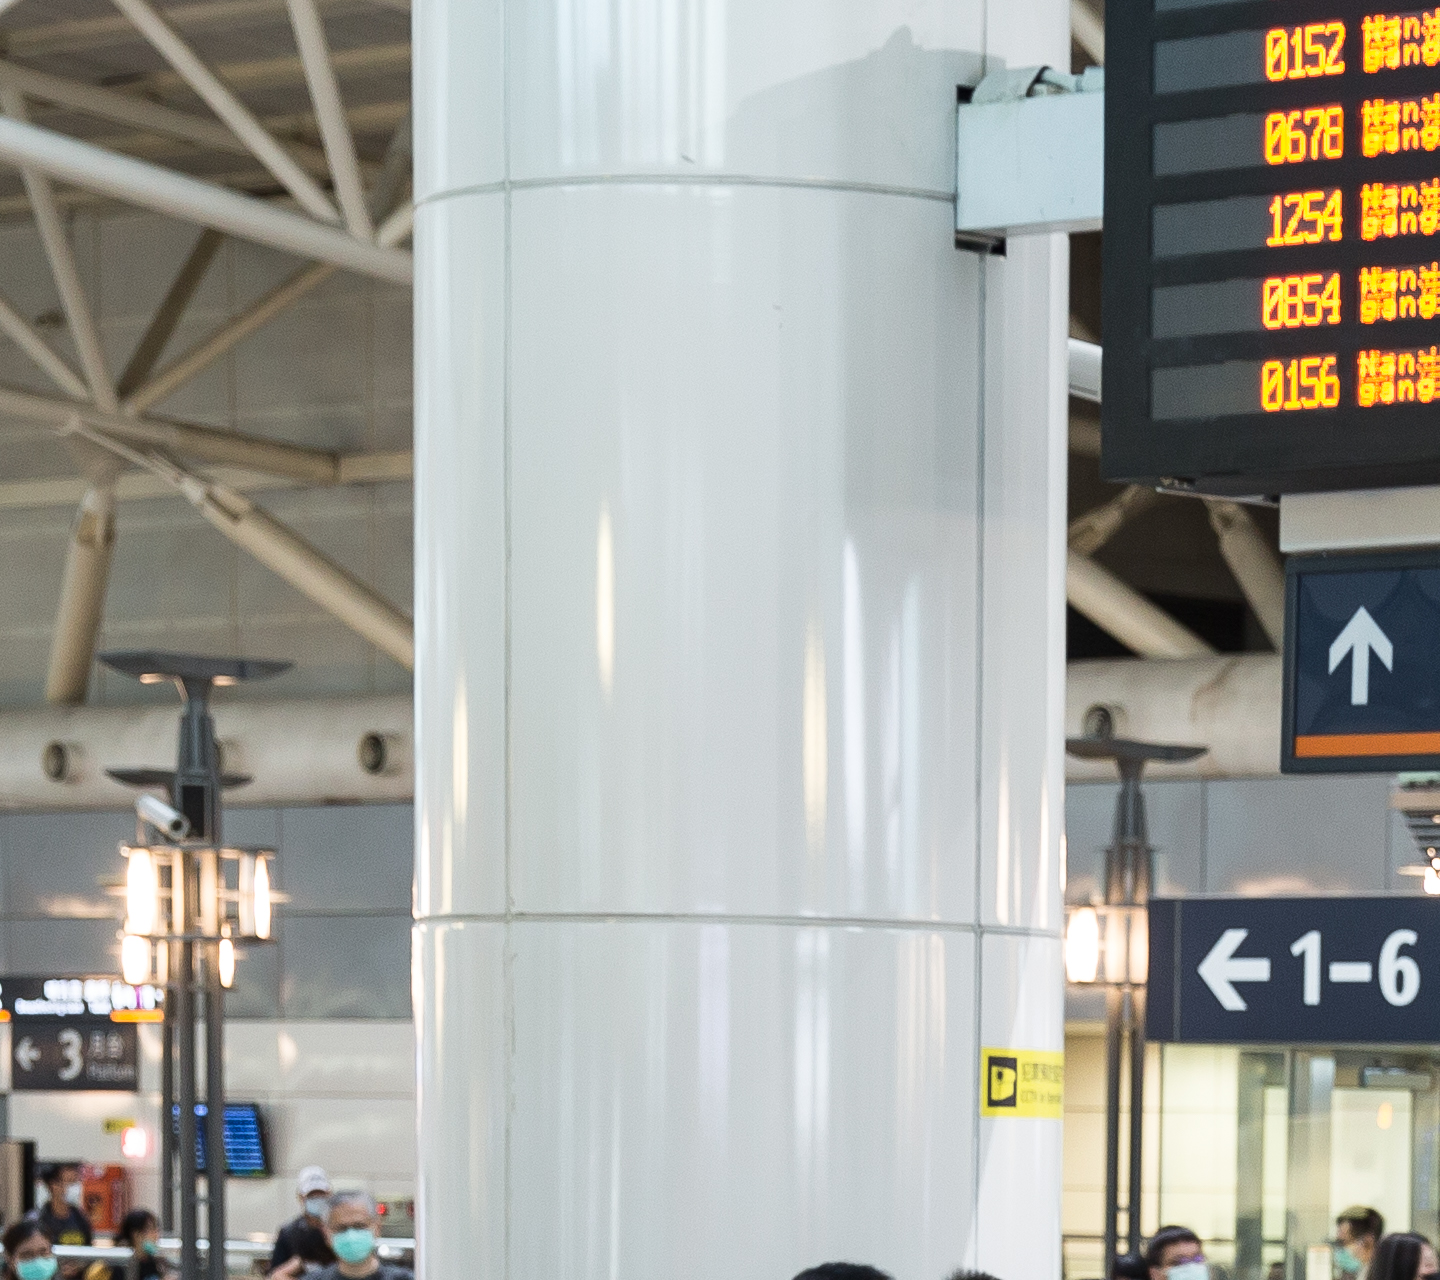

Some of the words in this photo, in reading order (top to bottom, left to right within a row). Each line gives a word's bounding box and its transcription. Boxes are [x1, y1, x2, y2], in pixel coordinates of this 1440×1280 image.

[1265, 21, 1346, 82] 0152
[1265, 106, 1344, 165] 0678
[1266, 189, 1343, 247] 1254
[1262, 272, 1341, 330] 0854
[1261, 356, 1340, 412] 0156
[1290, 928, 1421, 1007] 1-6
[57, 1028, 84, 1082] 3
